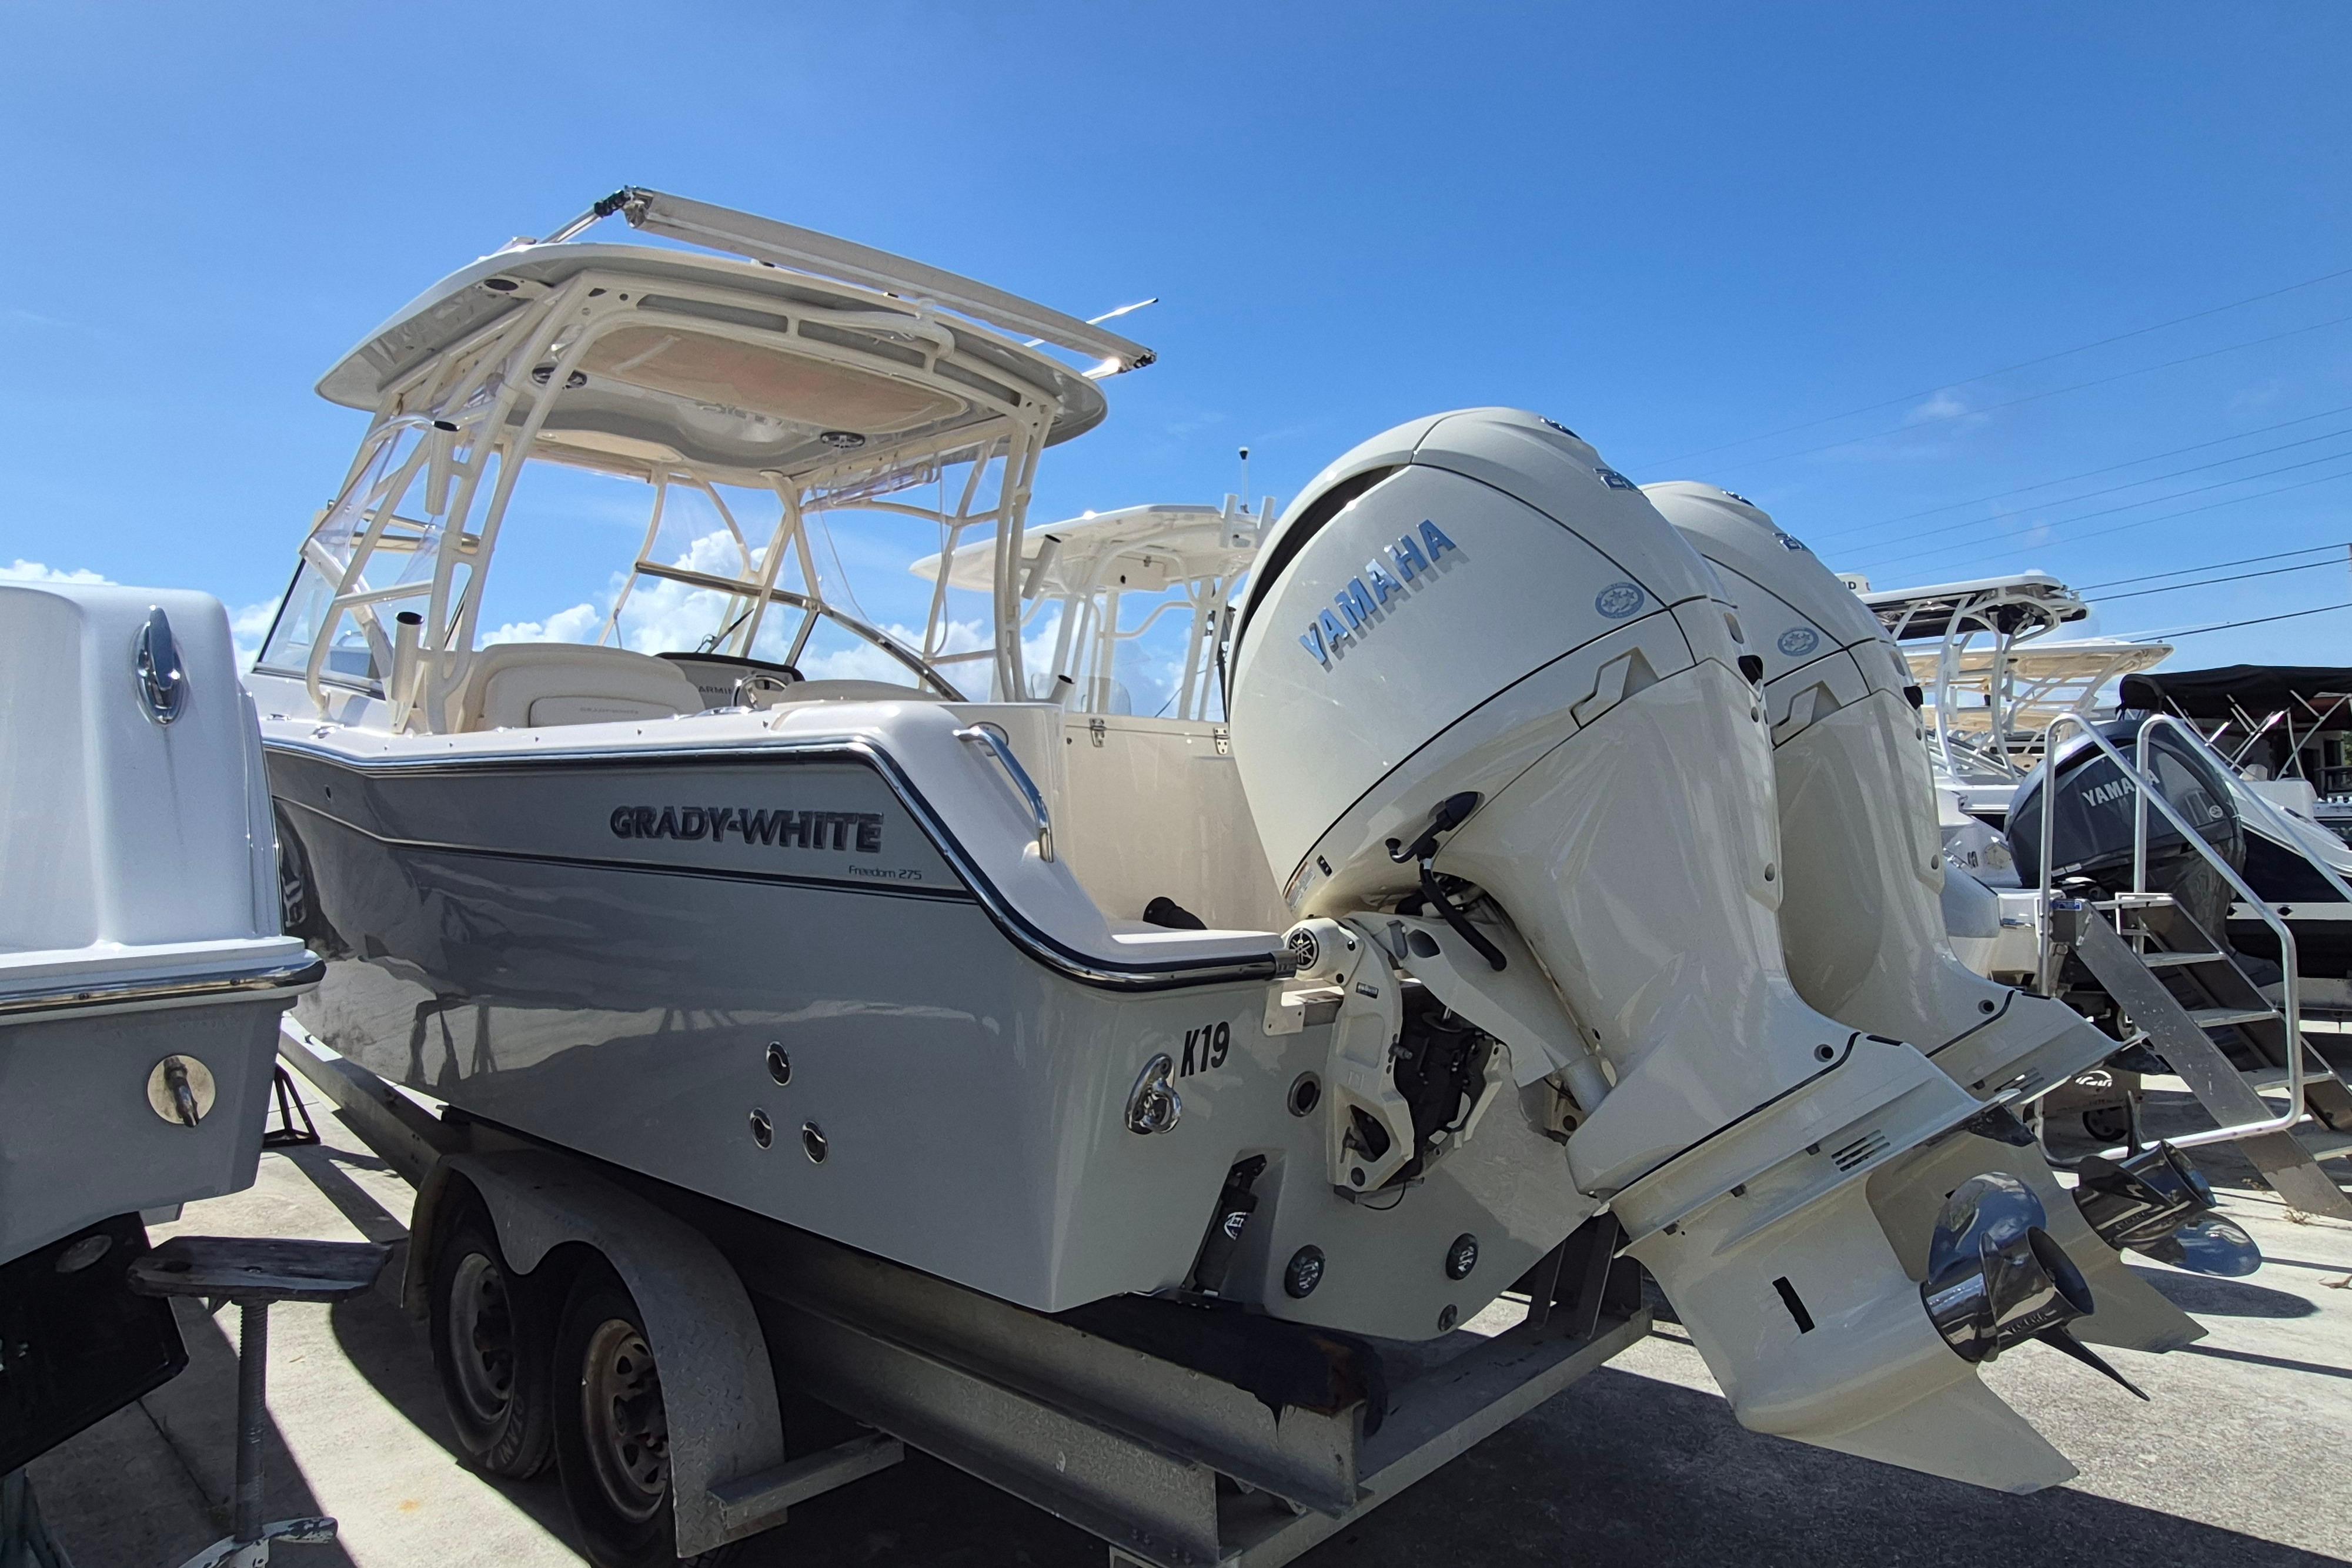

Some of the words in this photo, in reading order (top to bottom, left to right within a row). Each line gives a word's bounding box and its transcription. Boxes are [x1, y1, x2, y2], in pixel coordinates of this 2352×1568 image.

[1298, 519, 1456, 665] YAMAHA
[699, 686, 733, 695] ARMI
[2082, 769, 2160, 807] YAMAA
[610, 805, 884, 853] GRADY-WHITE
[848, 865, 896, 878] Freedom
[899, 869, 922, 880] 275
[1180, 1021, 1230, 1078] K19
